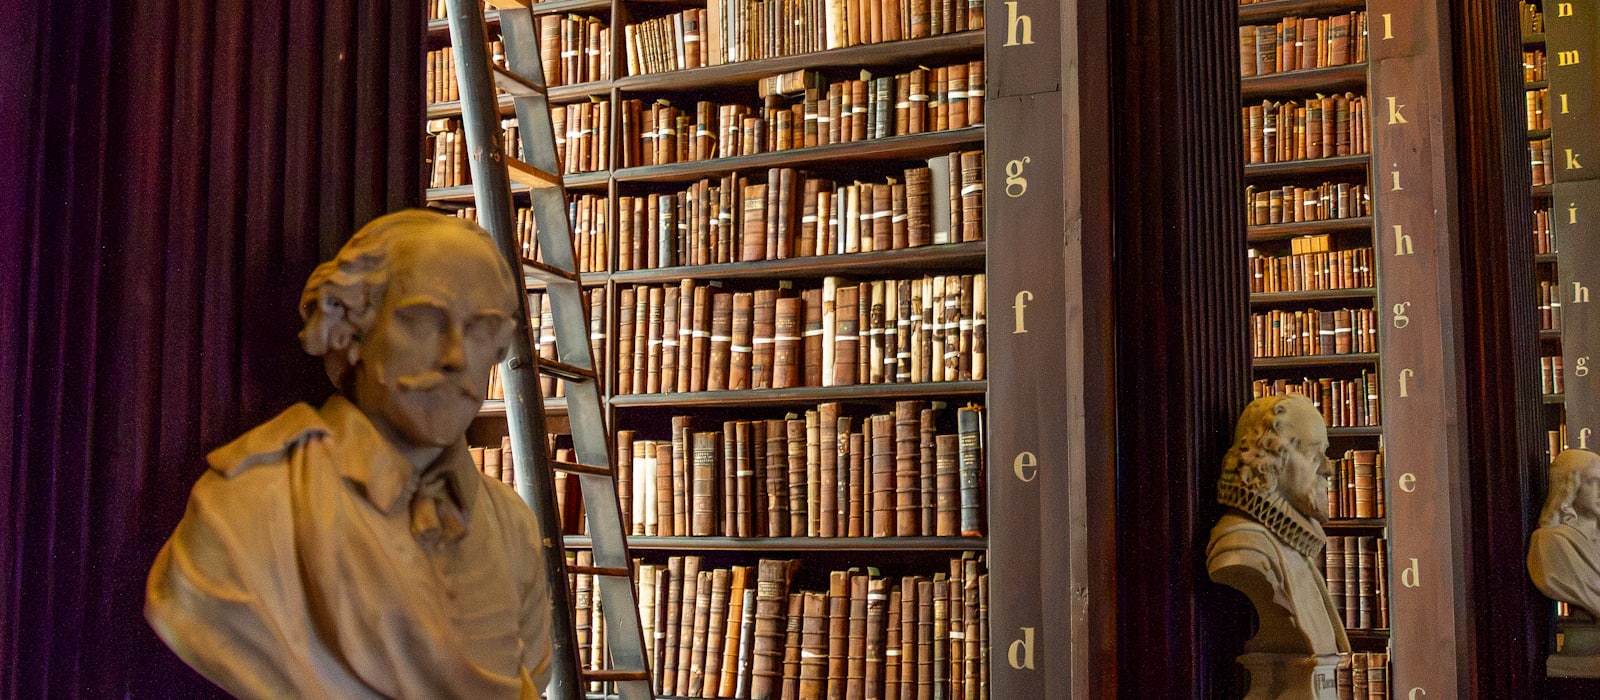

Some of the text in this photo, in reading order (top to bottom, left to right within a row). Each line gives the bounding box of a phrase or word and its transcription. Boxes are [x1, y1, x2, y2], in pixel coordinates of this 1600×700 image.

[1558, 2, 1573, 17] n
[1003, 1, 1035, 47] h
[1558, 49, 1580, 67] m
[1386, 96, 1408, 125] k
[1565, 149, 1583, 170] k
[1005, 156, 1031, 198] g
[1391, 163, 1403, 191] i
[1568, 202, 1578, 224] i
[1392, 225, 1414, 256] h
[1573, 282, 1589, 303] h
[1012, 290, 1033, 334] f
[1393, 301, 1411, 329] g
[1575, 356, 1590, 377] g
[1399, 368, 1413, 398] f
[1577, 427, 1592, 449] f
[1013, 451, 1037, 482] e
[1399, 472, 1416, 493] e
[1401, 558, 1420, 588] d
[1007, 627, 1035, 670] d
